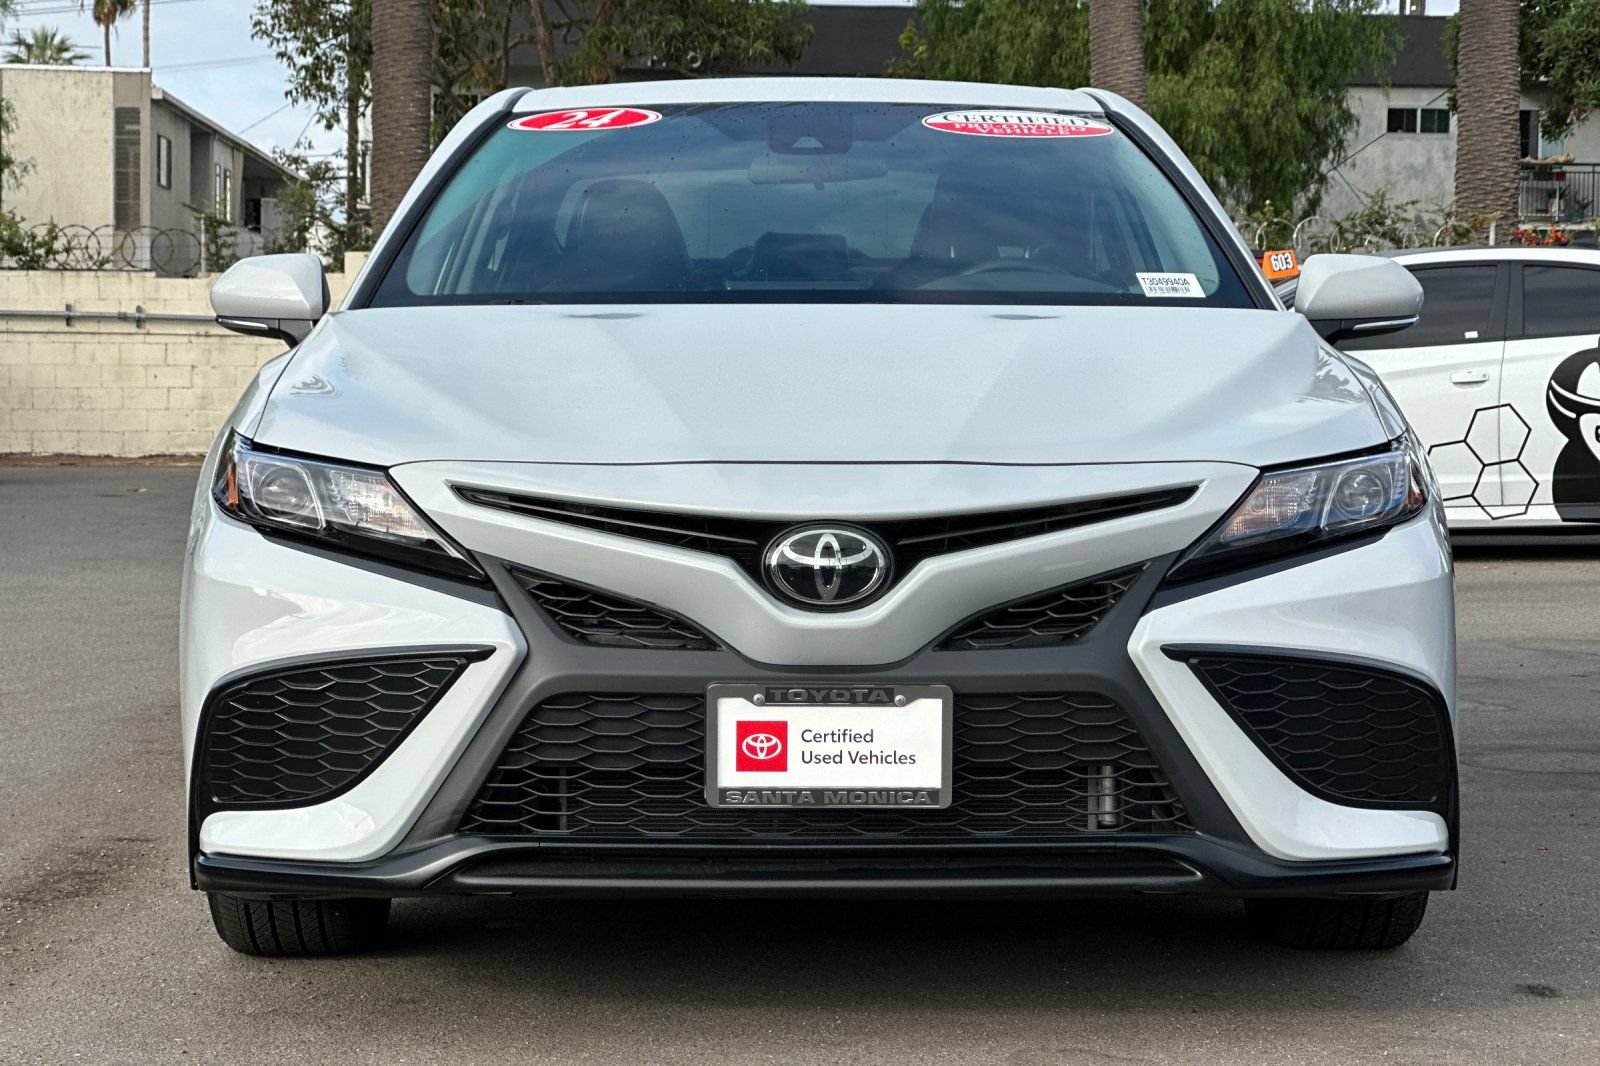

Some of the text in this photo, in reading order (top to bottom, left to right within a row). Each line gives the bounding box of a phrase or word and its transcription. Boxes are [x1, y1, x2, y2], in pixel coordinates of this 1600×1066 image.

[541, 109, 626, 129] 24
[942, 113, 1089, 126] CERTIFIED
[953, 123, 1087, 132] PRE-OWNED
[976, 127, 1071, 135] VEHICLE
[1271, 252, 1294, 271] 603
[769, 688, 890, 702] TOYOTA
[801, 728, 874, 743] Certified
[801, 750, 916, 765] Used Vehicles
[725, 791, 932, 804] SANTA MONICA
